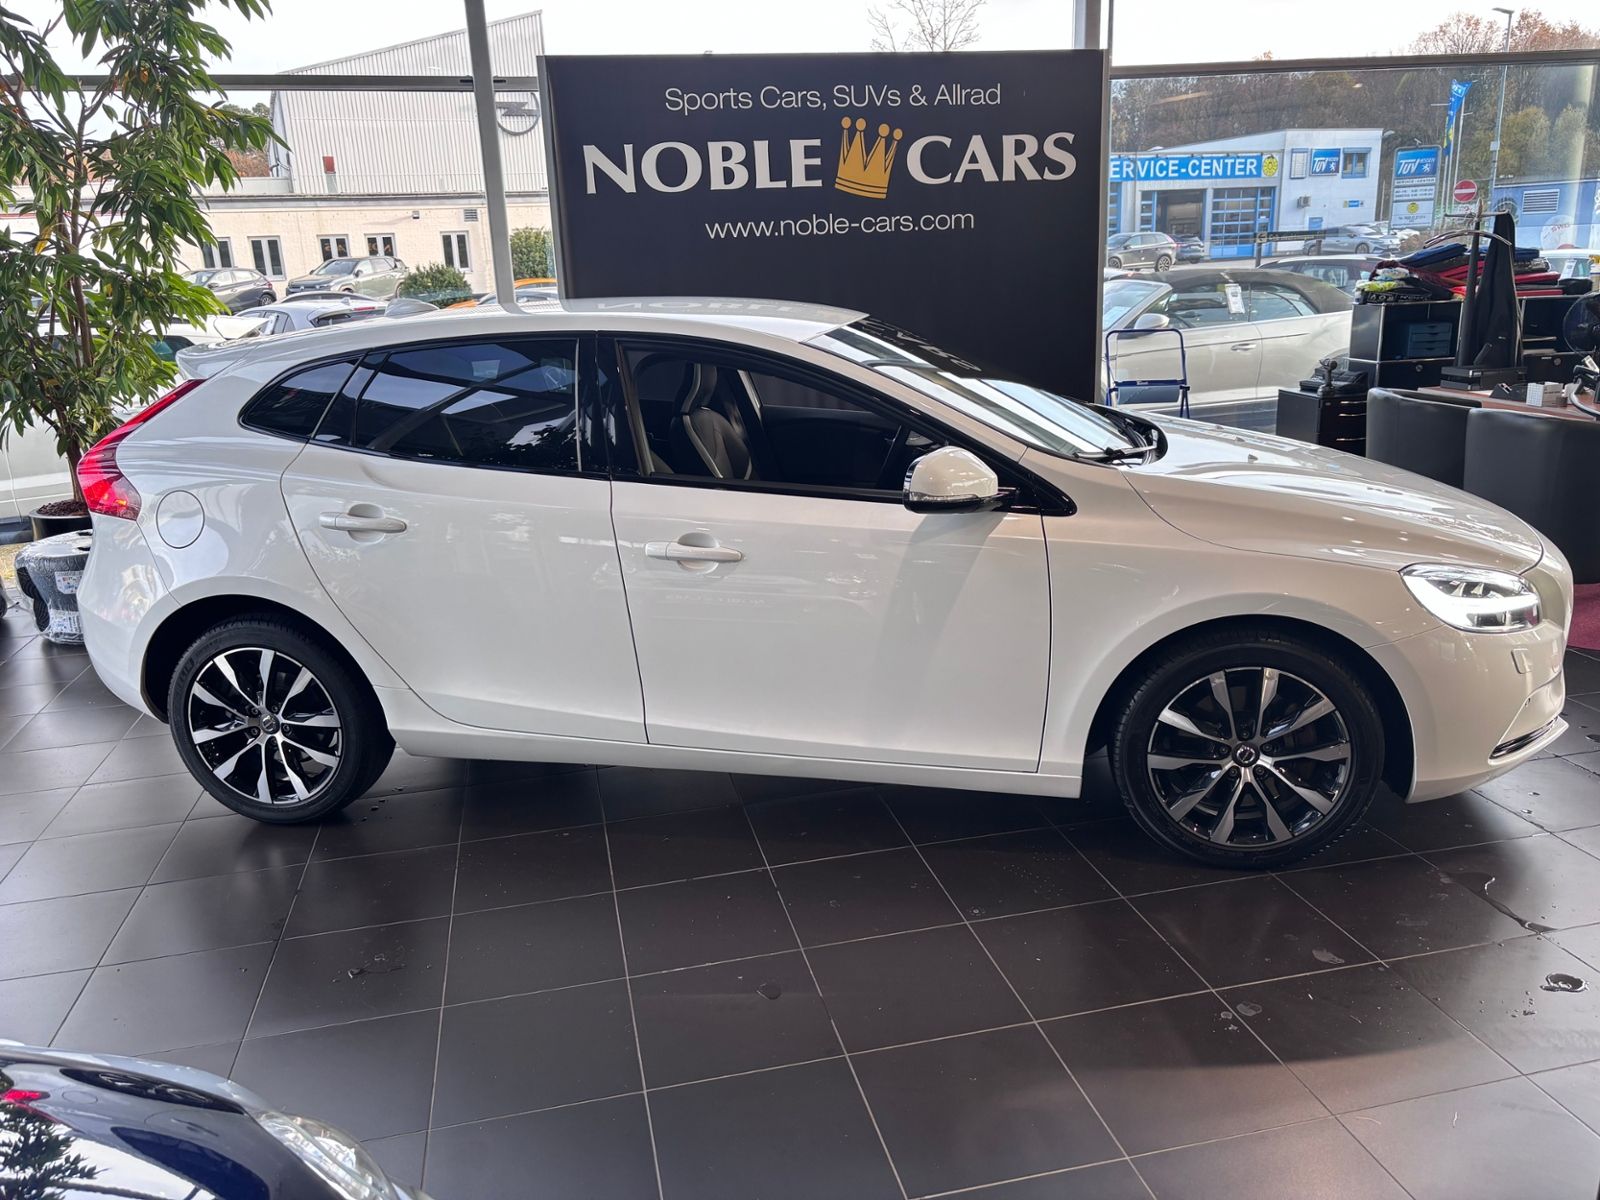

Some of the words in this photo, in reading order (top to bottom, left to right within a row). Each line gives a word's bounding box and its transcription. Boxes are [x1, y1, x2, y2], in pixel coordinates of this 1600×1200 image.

[665, 87, 753, 116] Sports
[760, 85, 827, 111] Cars,
[833, 84, 901, 107] SUVs
[909, 84, 928, 106] &
[934, 83, 1001, 105] Allrad
[582, 138, 823, 194] NOBLE
[906, 131, 1077, 185] CARS
[705, 213, 975, 240] www.noble-cars.com
